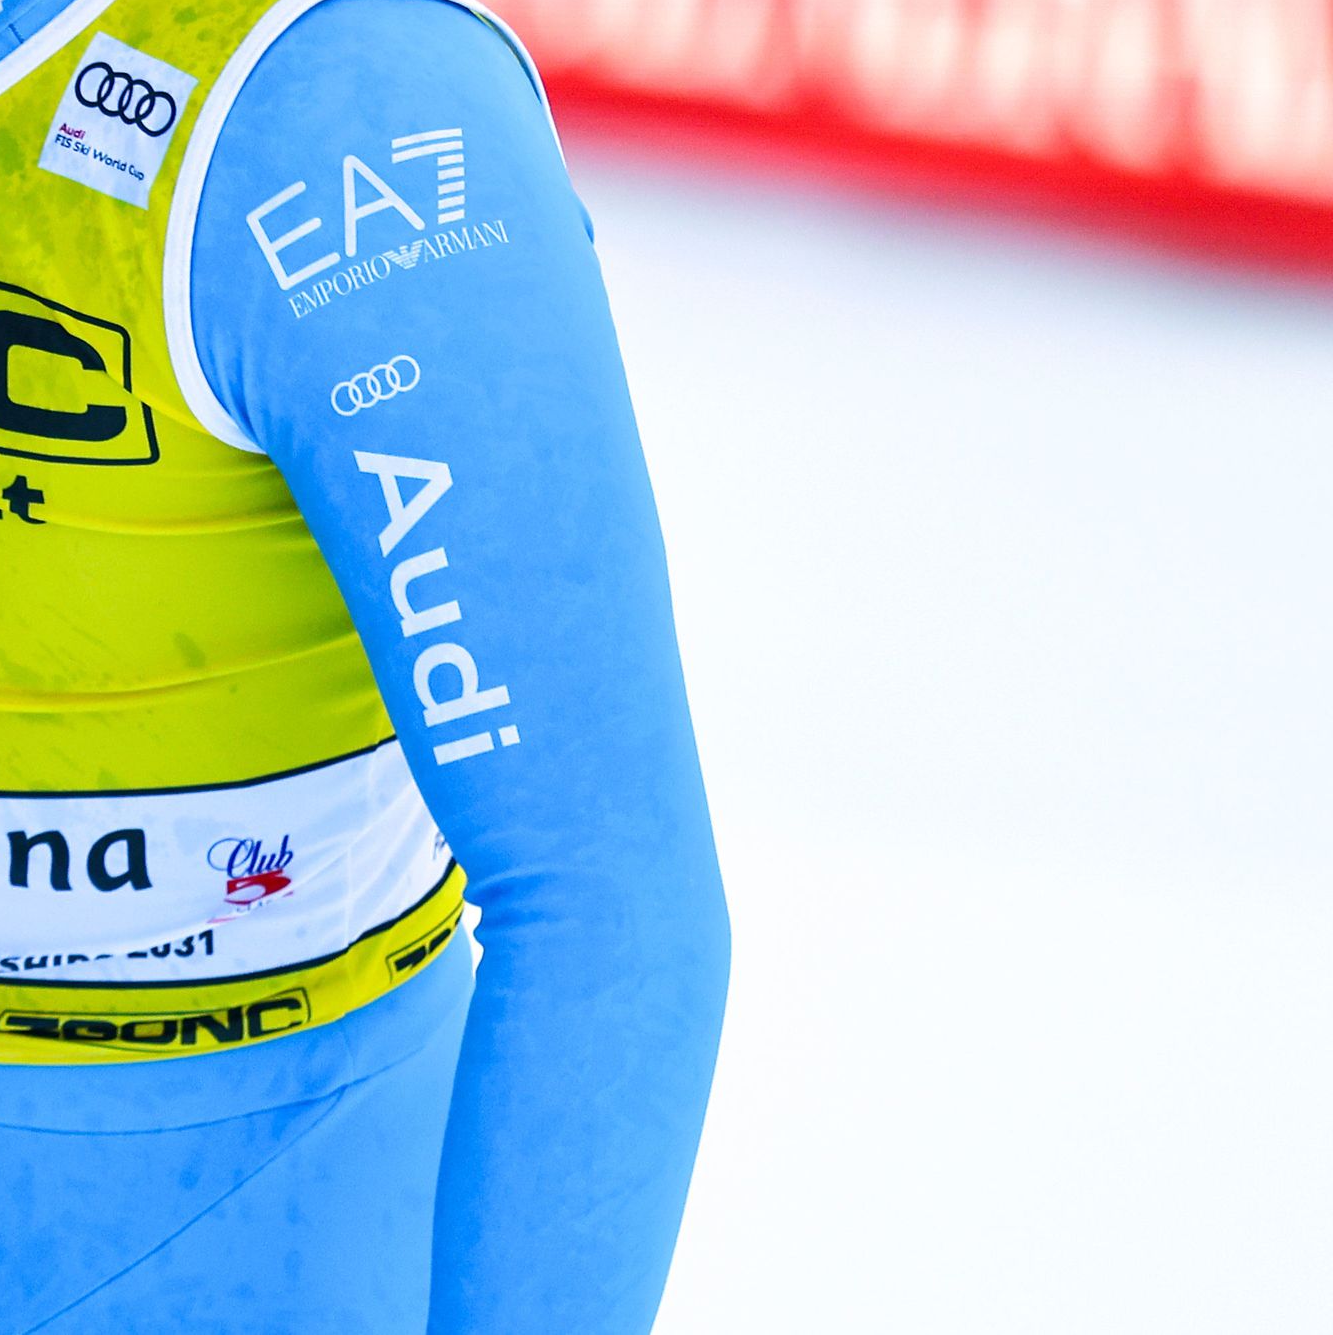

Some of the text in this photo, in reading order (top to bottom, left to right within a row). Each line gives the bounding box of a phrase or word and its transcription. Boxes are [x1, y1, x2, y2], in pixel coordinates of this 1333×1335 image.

[59, 122, 86, 141] Audi
[54, 133, 73, 149] FIS
[93, 148, 129, 173] World
[128, 164, 146, 181] Cup
[245, 127, 464, 292] EA7
[288, 219, 511, 320] EMPORIO ARMANI
[355, 450, 521, 767] Audi
[207, 834, 294, 880] Club
[224, 868, 292, 906] 5
